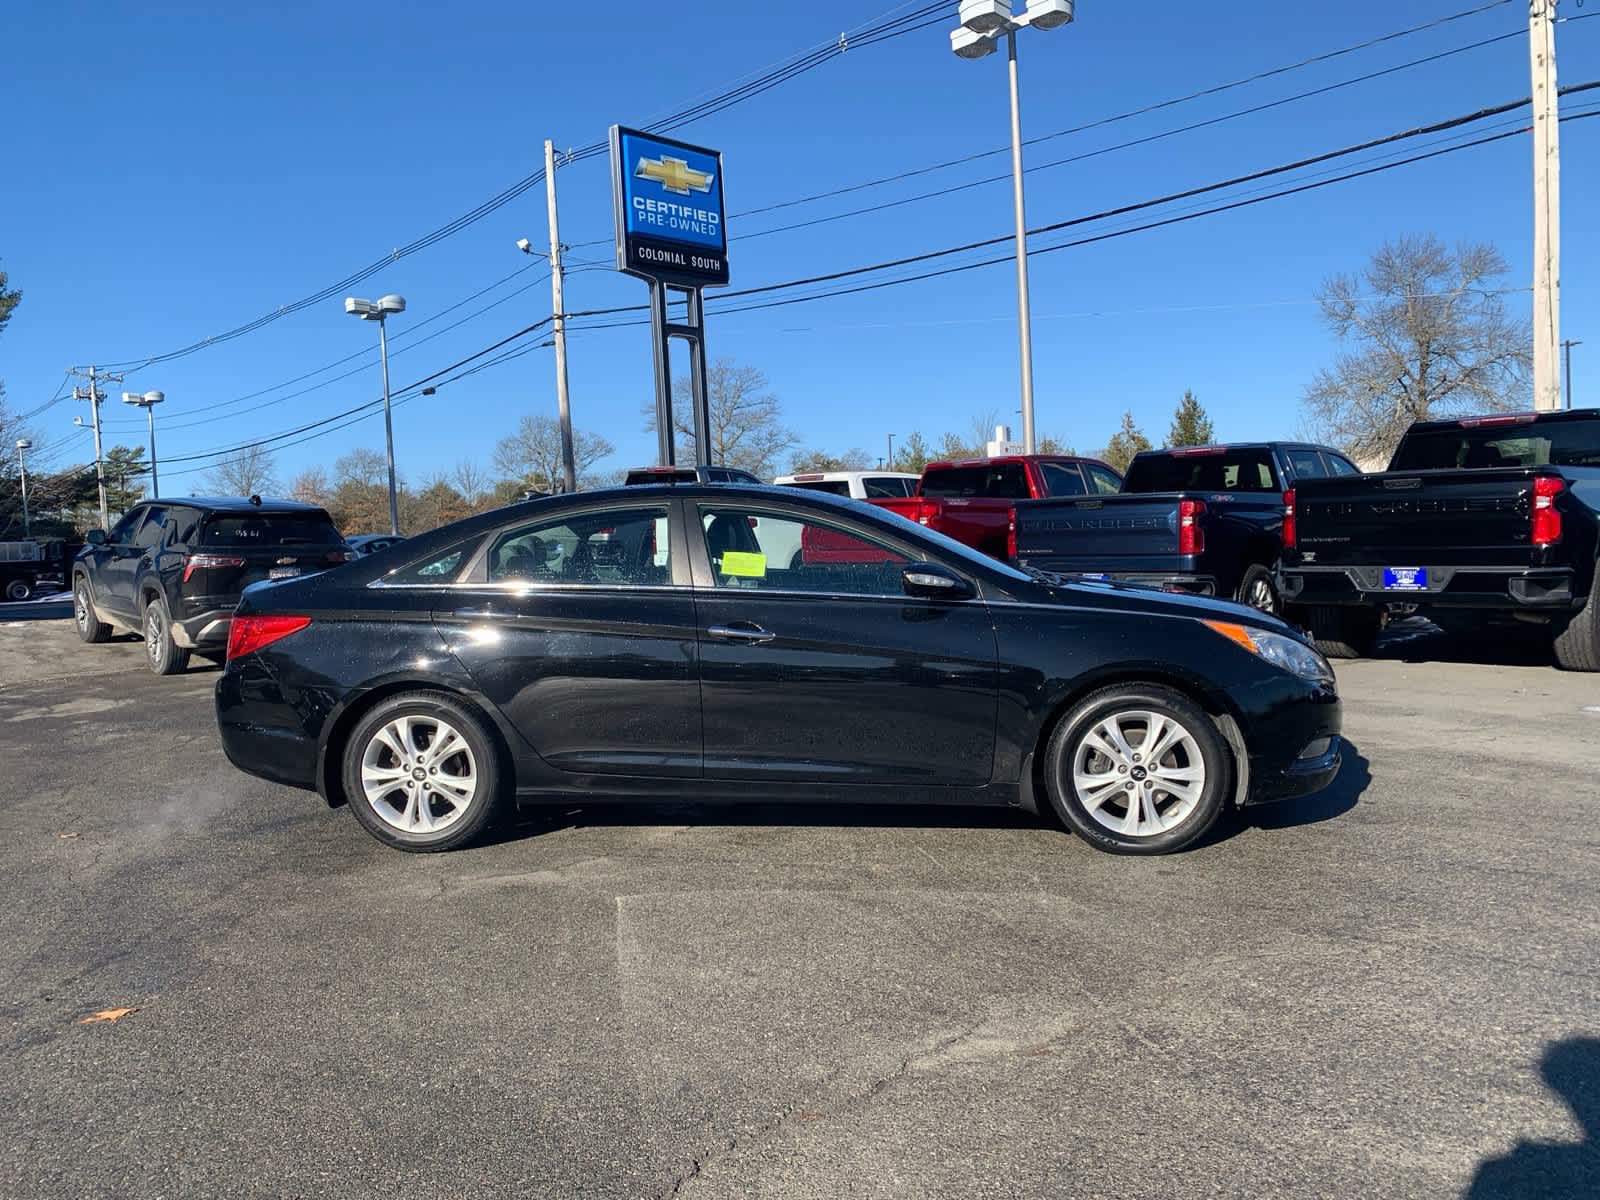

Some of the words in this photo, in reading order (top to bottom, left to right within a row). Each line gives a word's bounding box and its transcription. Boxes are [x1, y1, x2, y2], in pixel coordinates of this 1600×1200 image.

[633, 196, 719, 224] CERTIFIED
[638, 212, 716, 236] PRE-OWNED
[638, 247, 687, 265] COLONIAL
[691, 255, 721, 271] SOUTH
